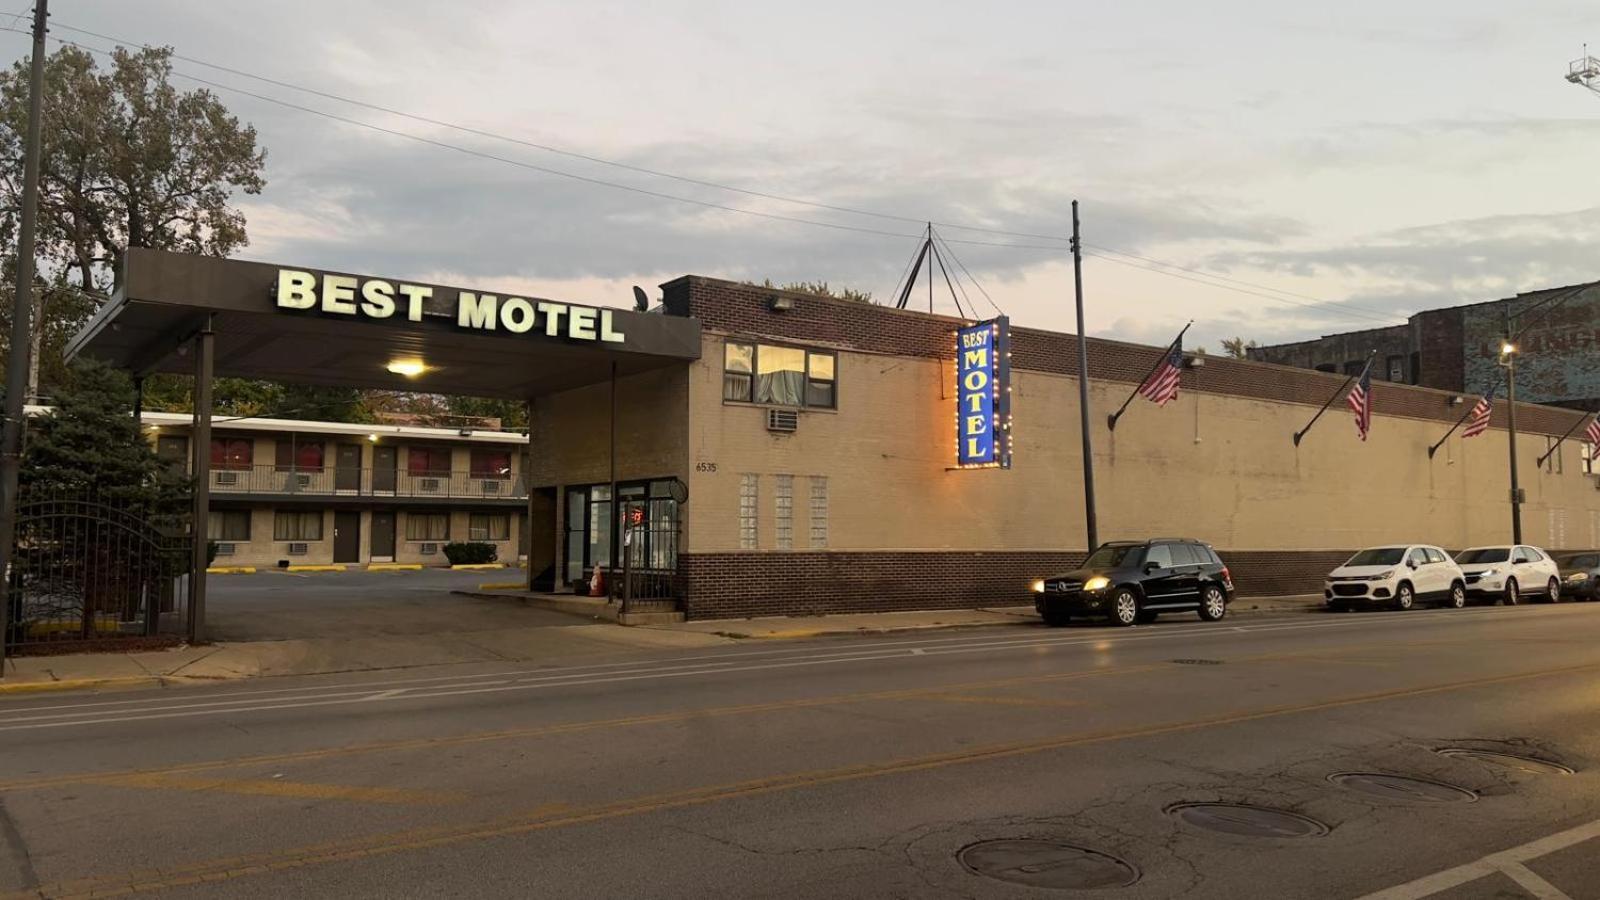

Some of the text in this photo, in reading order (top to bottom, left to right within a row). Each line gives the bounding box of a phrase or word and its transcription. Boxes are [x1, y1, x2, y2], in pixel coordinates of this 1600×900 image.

[277, 269, 625, 343] BEST MOTEL
[962, 330, 989, 348] BEST
[964, 348, 988, 458] MOTEL
[696, 462, 717, 472] 6535
